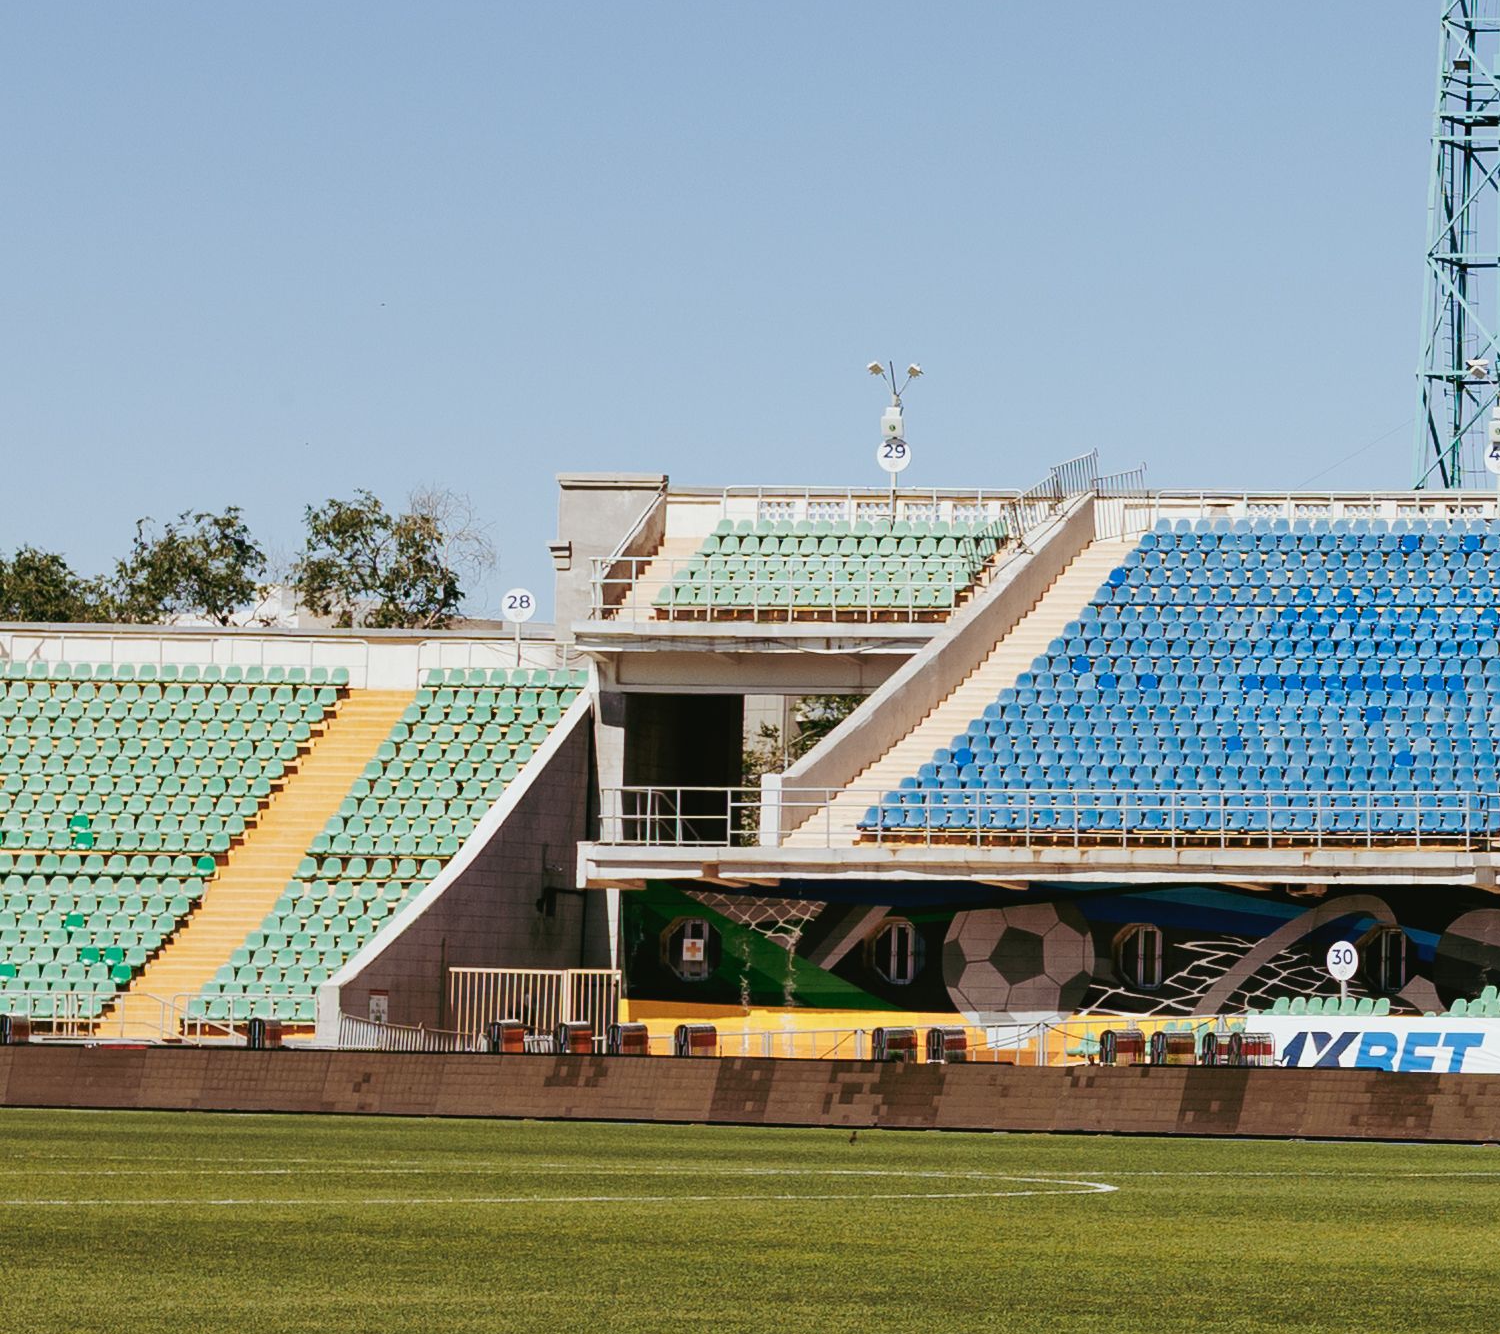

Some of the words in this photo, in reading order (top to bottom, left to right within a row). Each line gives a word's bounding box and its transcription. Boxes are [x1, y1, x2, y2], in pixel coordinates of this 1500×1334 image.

[883, 443, 906, 459] 29
[507, 594, 531, 609] 28
[1332, 948, 1353, 966] 30
[1281, 1031, 1486, 1073] 1XBET
